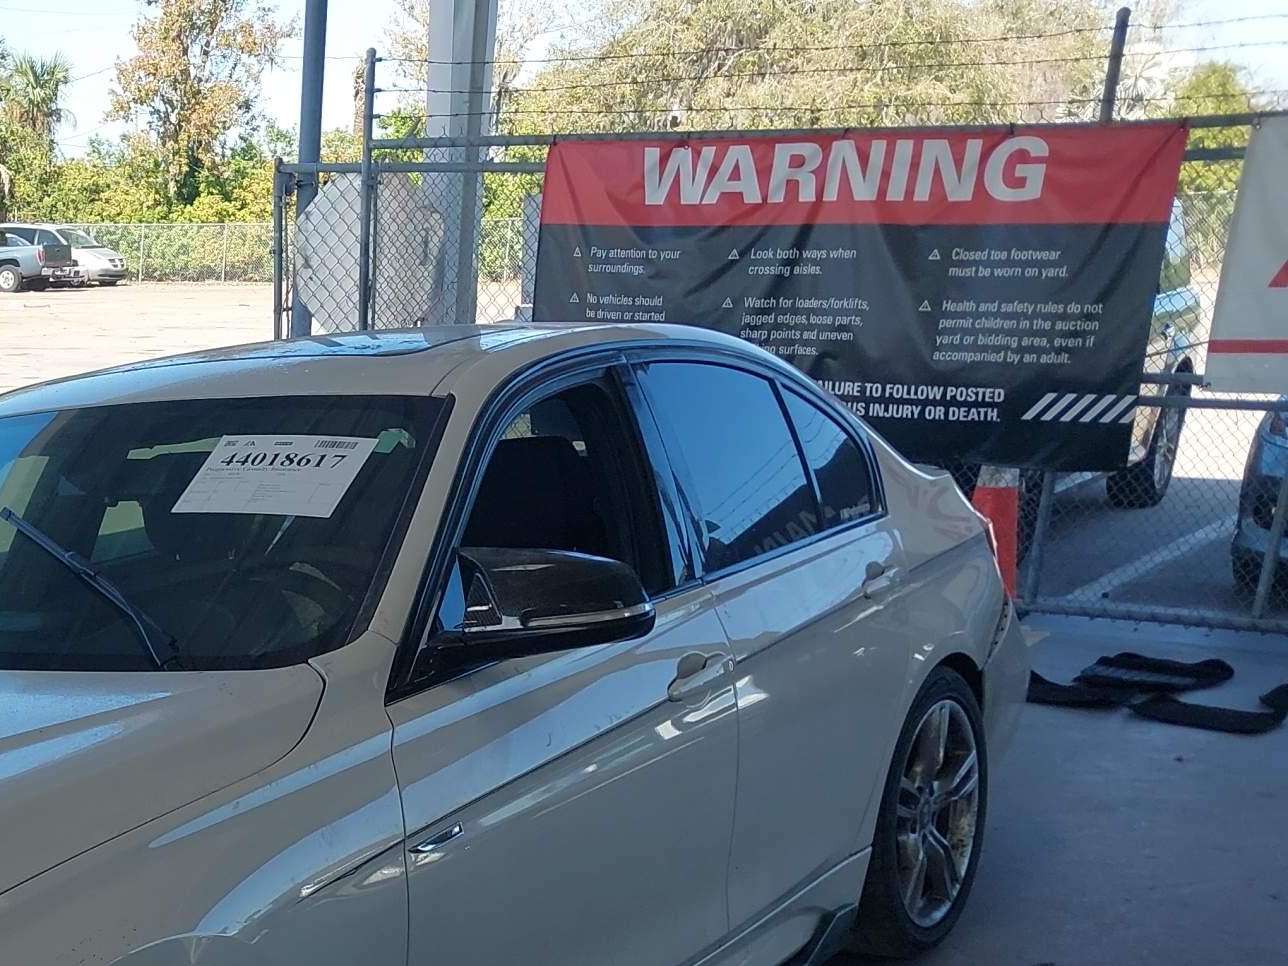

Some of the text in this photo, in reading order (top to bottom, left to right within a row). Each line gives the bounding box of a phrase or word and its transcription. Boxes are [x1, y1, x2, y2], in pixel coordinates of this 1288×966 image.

[643, 136, 1050, 206] WARNING
[591, 247, 680, 260] Pay attention to your
[751, 248, 856, 261] Look both ways when
[952, 248, 1060, 260] Closed toe footwear
[588, 263, 645, 275] surroundings.
[748, 265, 822, 277] crossing aisles.
[949, 266, 1068, 279] must be worn on yard.
[587, 294, 662, 305] No vehicles should
[744, 297, 870, 311] Watch for loaders/forklifts,
[942, 300, 1103, 315] Health and safety rules do not
[586, 309, 665, 321] be driven or started
[741, 313, 863, 327] jagged edges, loose parts,
[939, 318, 1099, 331] permit children in the auction
[741, 328, 853, 340] sharp points and uneven
[936, 333, 1095, 348] yard or bidding area, even if
[779, 344, 818, 354] surfaces.
[933, 350, 1071, 365] accompanied by an adult.
[866, 383, 882, 398] TO
[886, 384, 944, 400] FOLLOW
[947, 386, 1004, 402] POSTED
[870, 403, 921, 419] INJURY
[925, 406, 946, 420] OR
[949, 407, 1000, 422] DEATH.
[220, 451, 348, 469] 44018617
